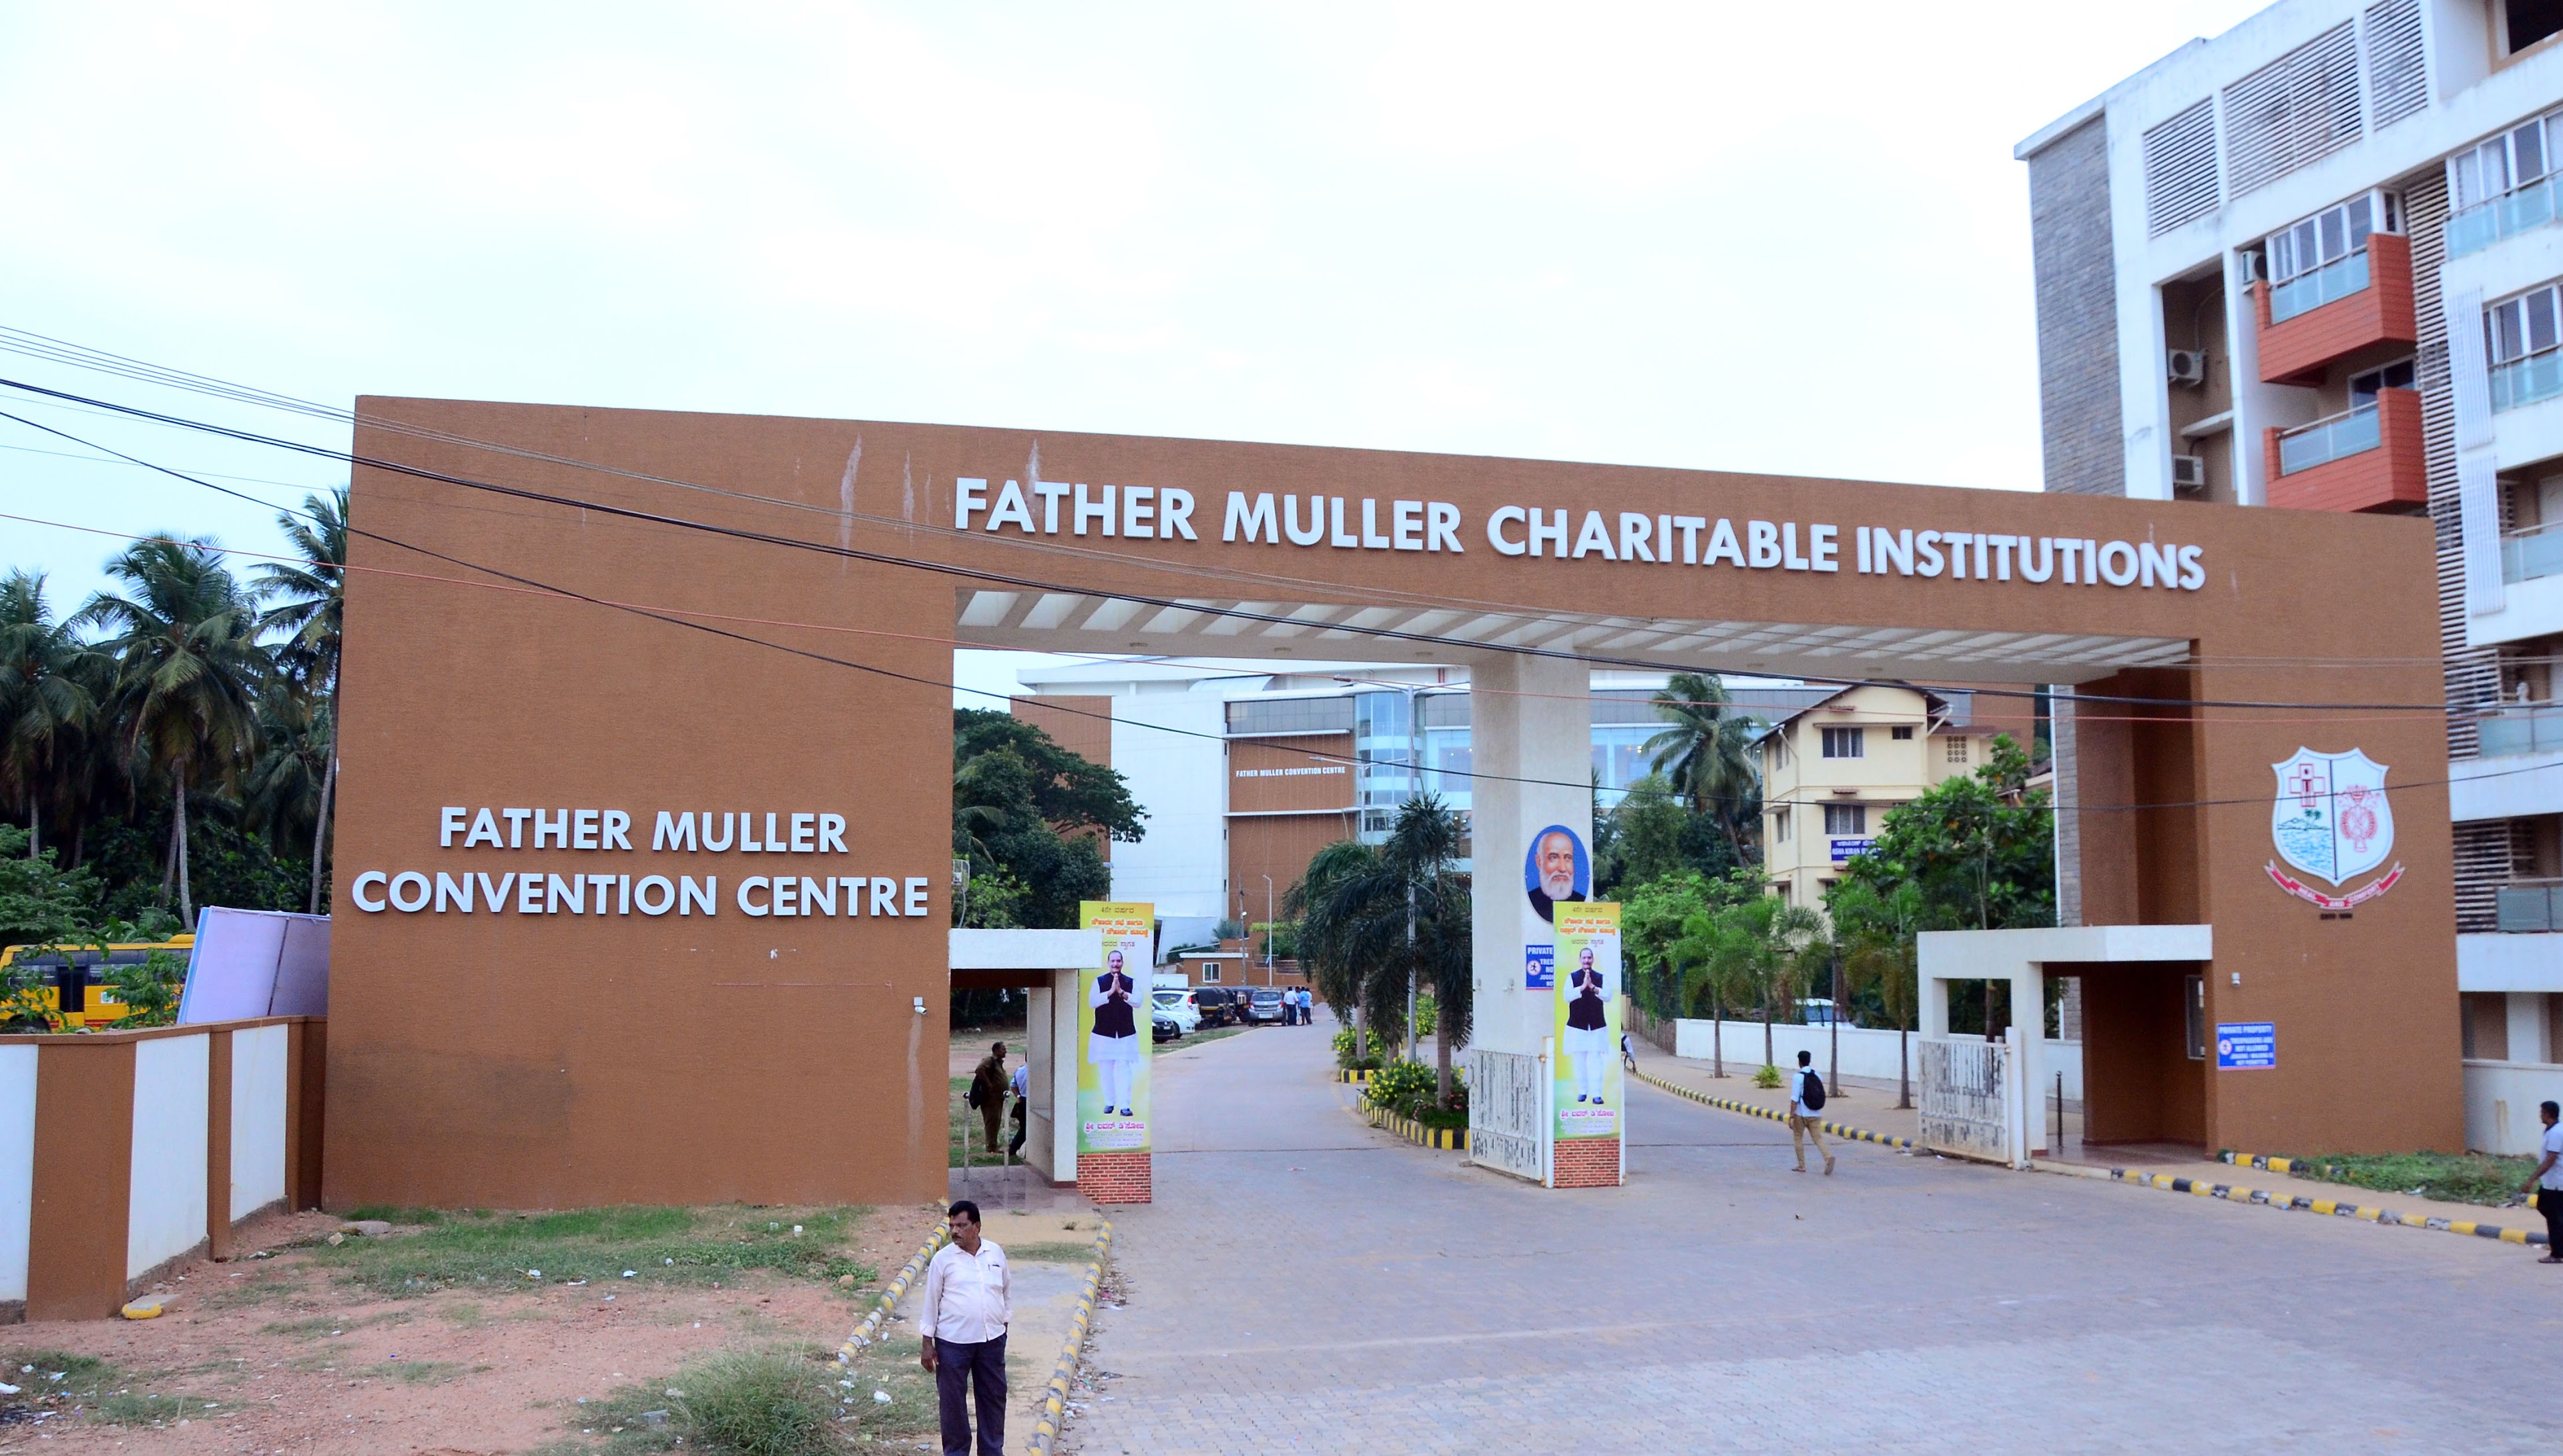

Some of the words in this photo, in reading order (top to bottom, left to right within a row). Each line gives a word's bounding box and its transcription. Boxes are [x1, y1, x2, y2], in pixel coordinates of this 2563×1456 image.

[954, 476, 1198, 540] FATHER
[1222, 490, 1464, 553] MULLER
[1486, 504, 1839, 573] CHARITABLE
[1856, 526, 2206, 591] INSTITUTIONS
[1236, 769, 1257, 777] FATHER
[1259, 769, 1284, 777] MULLER
[1284, 767, 1322, 776] CONVENTION
[441, 806, 633, 850] FATHER
[652, 811, 849, 853] MULLER
[352, 870, 717, 916] CONVENTION
[737, 875, 928, 917] CENTRE
